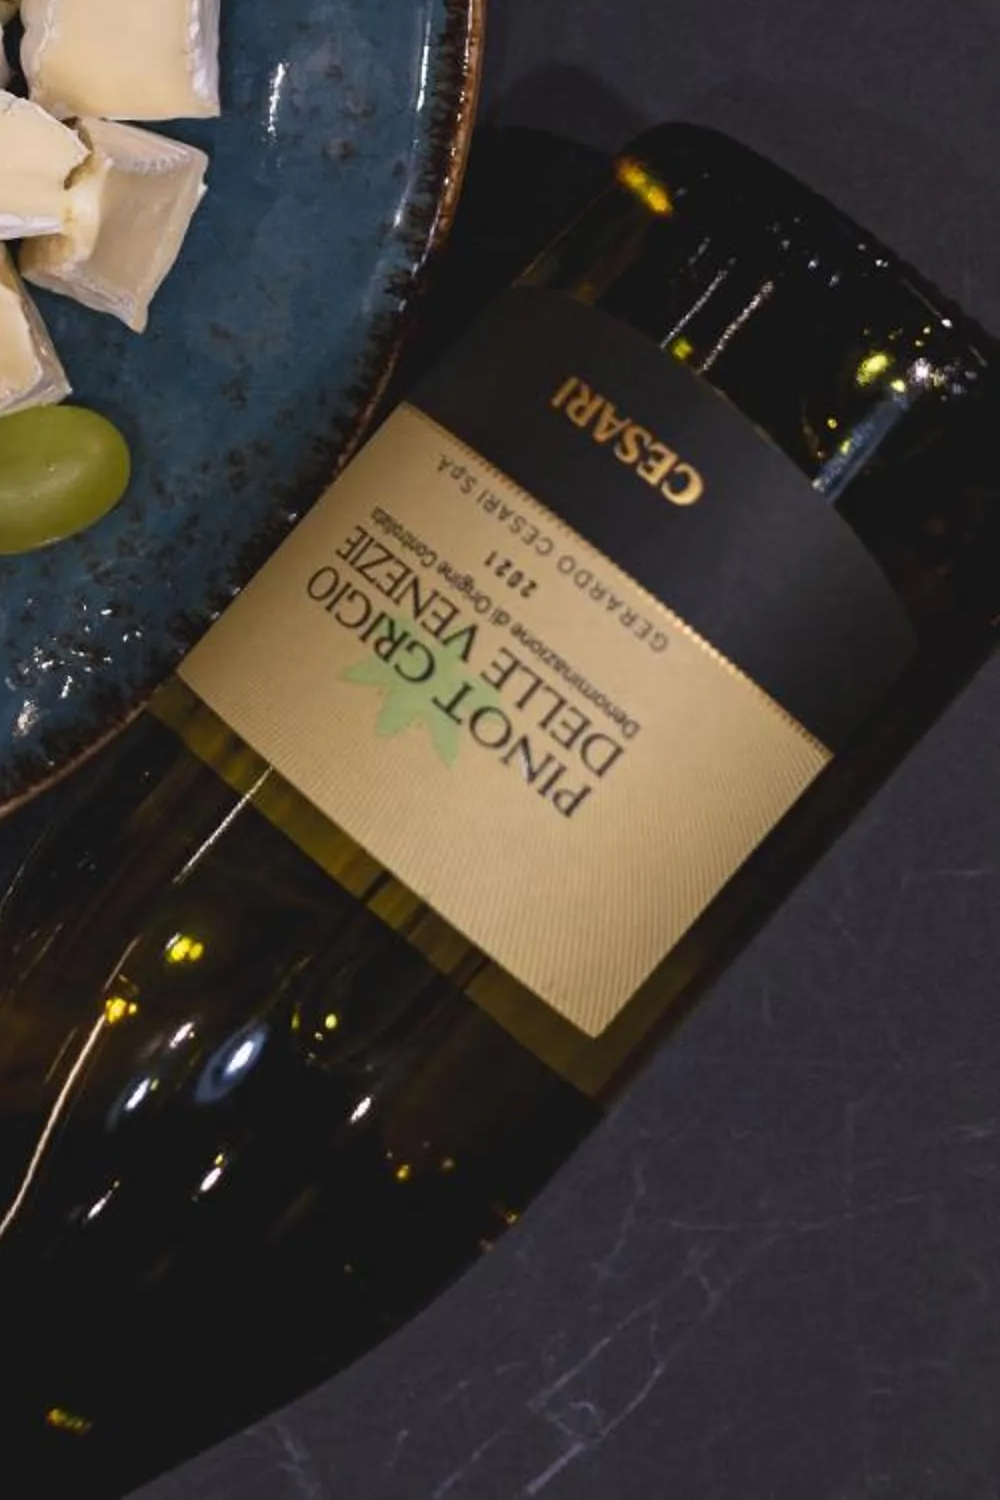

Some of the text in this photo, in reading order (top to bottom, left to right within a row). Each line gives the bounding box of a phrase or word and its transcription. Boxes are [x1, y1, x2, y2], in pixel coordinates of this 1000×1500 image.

[551, 377, 703, 506] CESARI
[478, 489, 554, 557] CESARI
[437, 562, 492, 614] Origine
[484, 551, 537, 598] 2021
[491, 608, 511, 626] di
[557, 555, 669, 653] GERARDO
[306, 566, 592, 818] PINOT GRIGIO
[335, 525, 624, 779] DELLE VENEZIE
[510, 621, 641, 740] Denominazione
